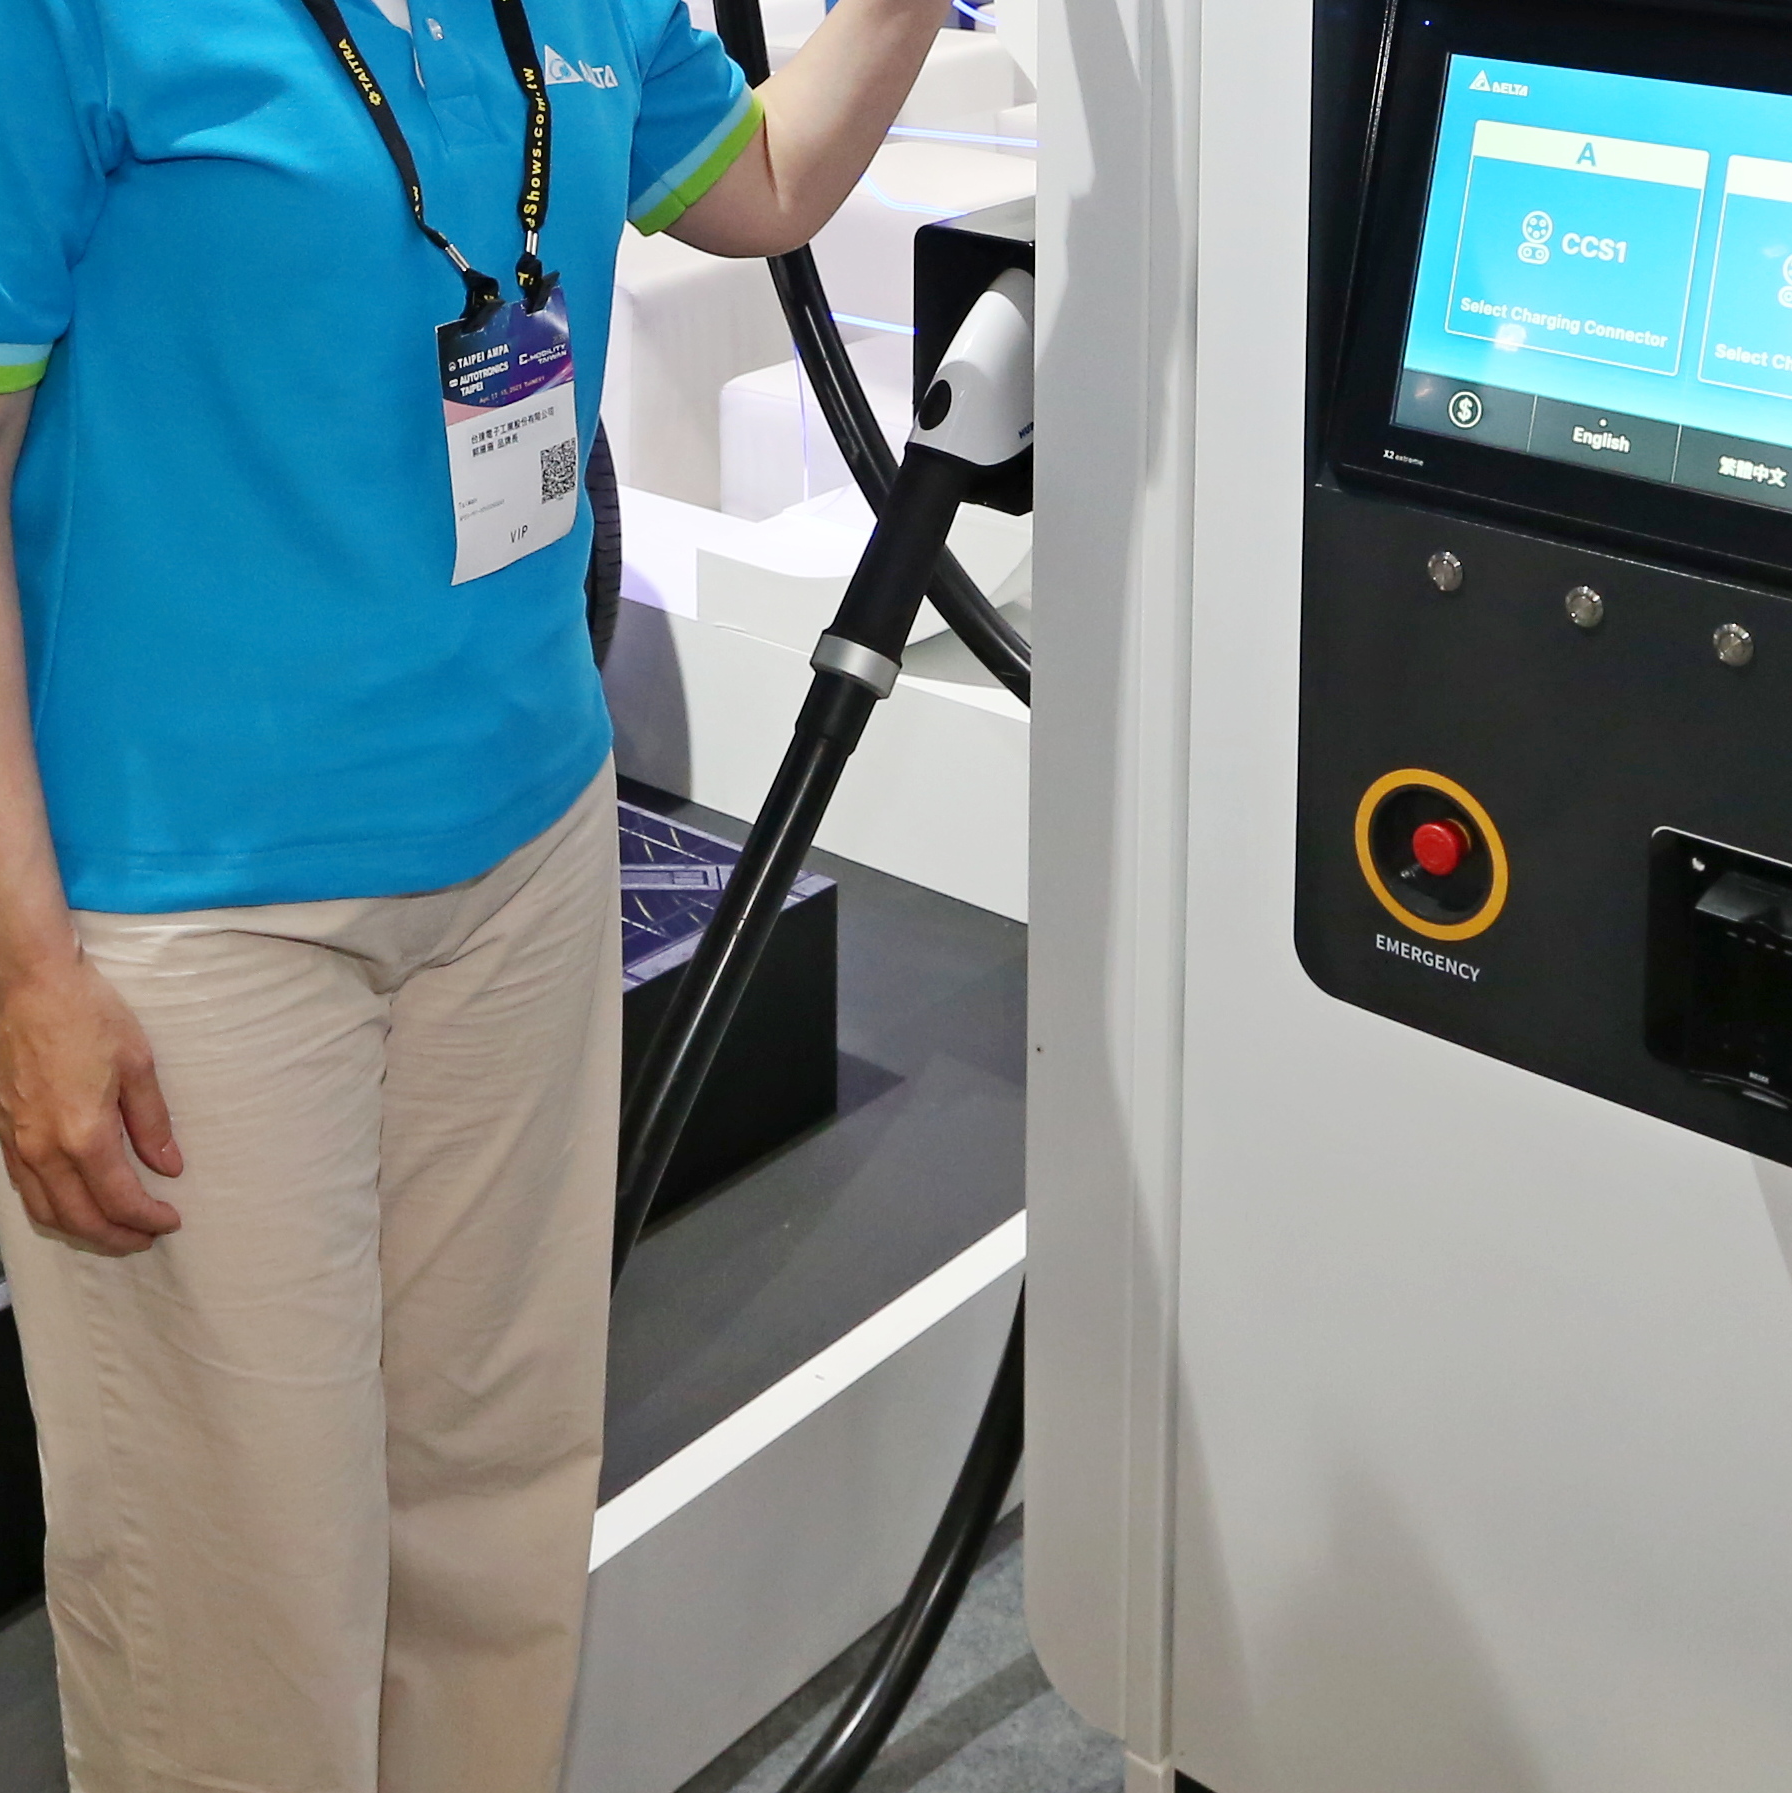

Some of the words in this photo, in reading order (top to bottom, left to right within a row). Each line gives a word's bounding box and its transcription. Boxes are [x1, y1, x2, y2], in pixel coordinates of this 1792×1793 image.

[338, 38, 373, 92] TAITRA
[1492, 80, 1529, 97] DELTA
[1576, 142, 1597, 167] A
[1561, 232, 1628, 264] CCS1
[1460, 297, 1508, 319] Select
[1510, 306, 1580, 336] Charging
[1583, 320, 1669, 350] Connector
[457, 351, 485, 368] TAIPEI
[1714, 342, 1769, 369] Select
[459, 361, 509, 386] AUTOTRONICS
[460, 381, 484, 397] TAIPEI
[1572, 426, 1631, 453] English
[510, 524, 528, 543] VIP
[1376, 933, 1480, 982] EMERGENCY
